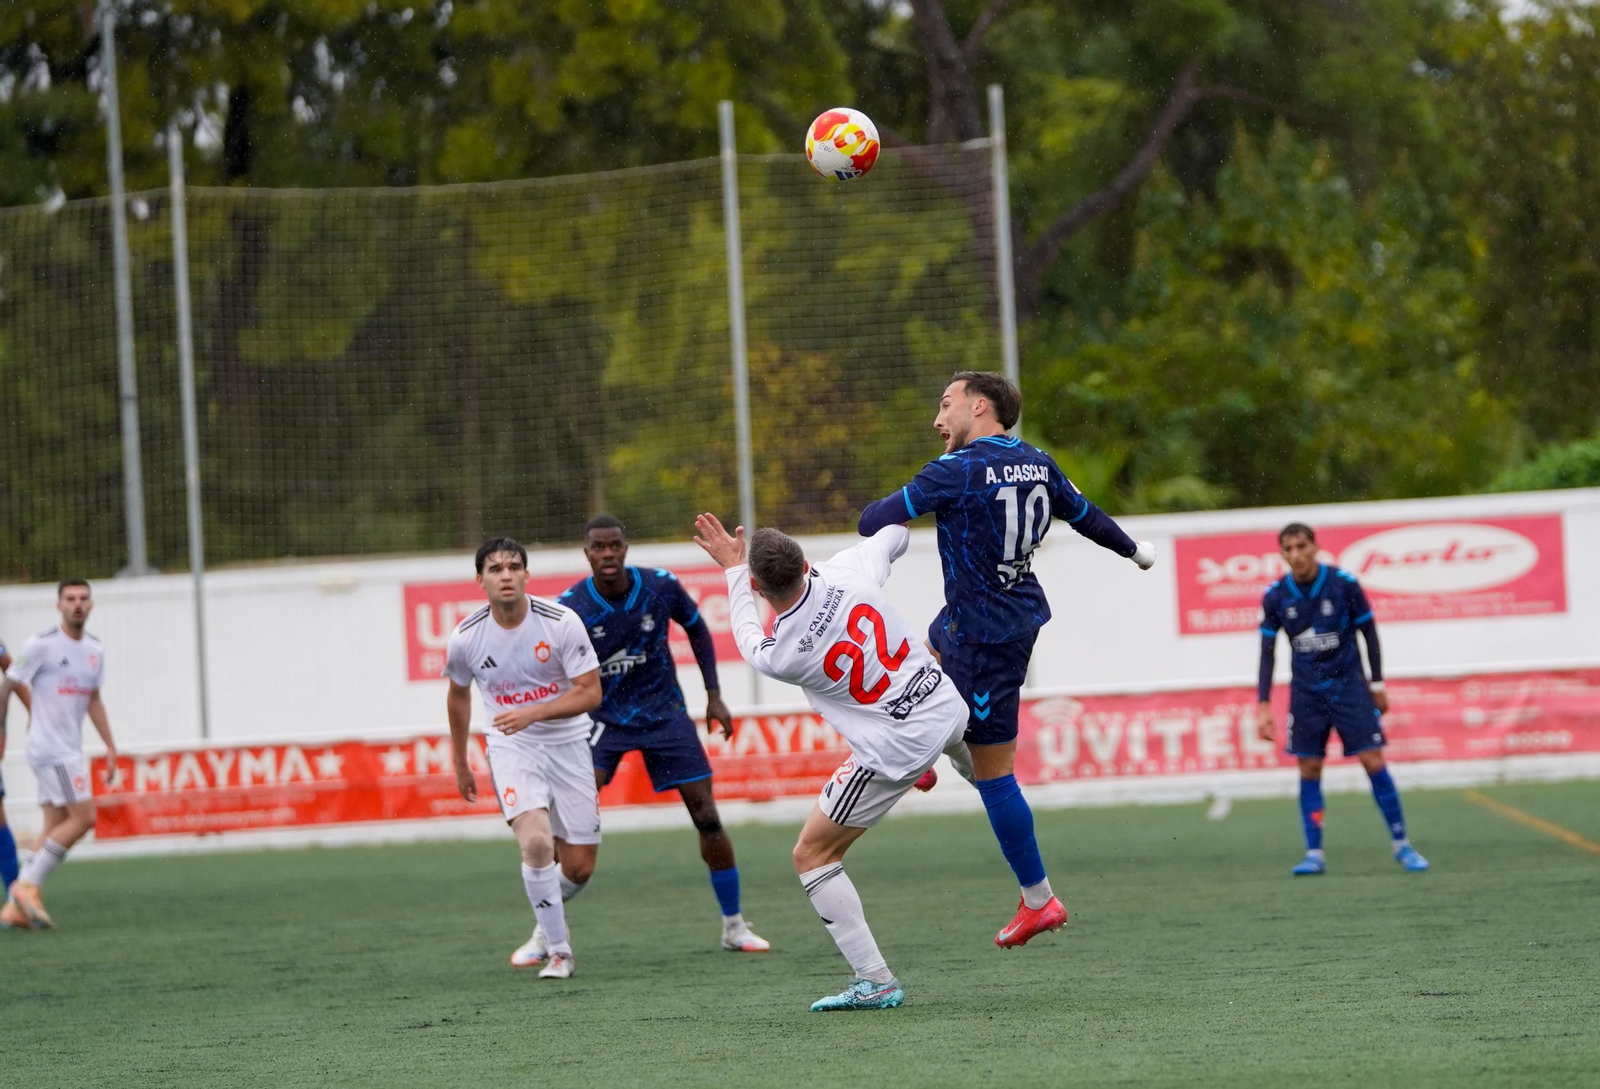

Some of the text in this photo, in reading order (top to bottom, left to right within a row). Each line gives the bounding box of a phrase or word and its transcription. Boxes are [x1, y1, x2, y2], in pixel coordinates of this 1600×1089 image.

[985, 466, 1002, 484] A.
[995, 483, 1050, 561] 10
[809, 611, 826, 632] CAJA
[815, 589, 845, 638] DE UTRERA
[823, 603, 911, 705] 22
[1037, 706, 1276, 768] UVITEL
[133, 745, 315, 795] MAYMA
